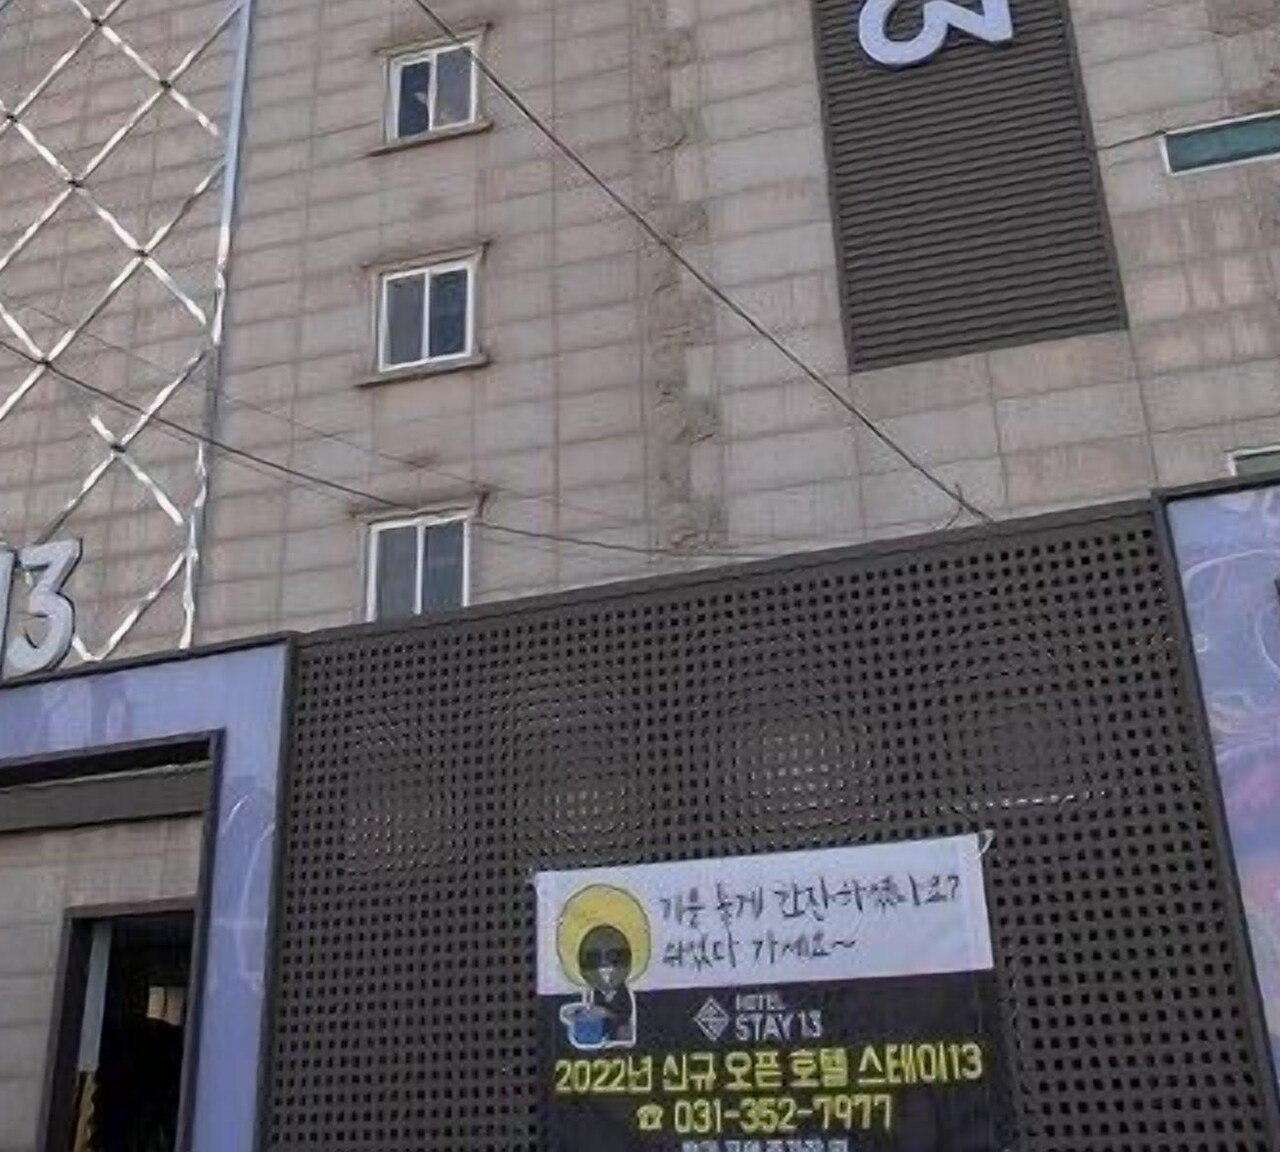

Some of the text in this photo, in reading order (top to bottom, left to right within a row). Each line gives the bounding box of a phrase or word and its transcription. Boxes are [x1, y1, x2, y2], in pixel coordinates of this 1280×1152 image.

[734, 1010, 795, 1041] STAY
[555, 1042, 983, 1094] 2022년 신규 오픈 호텔 스테이13
[674, 1094, 892, 1134] 031-352-7977
